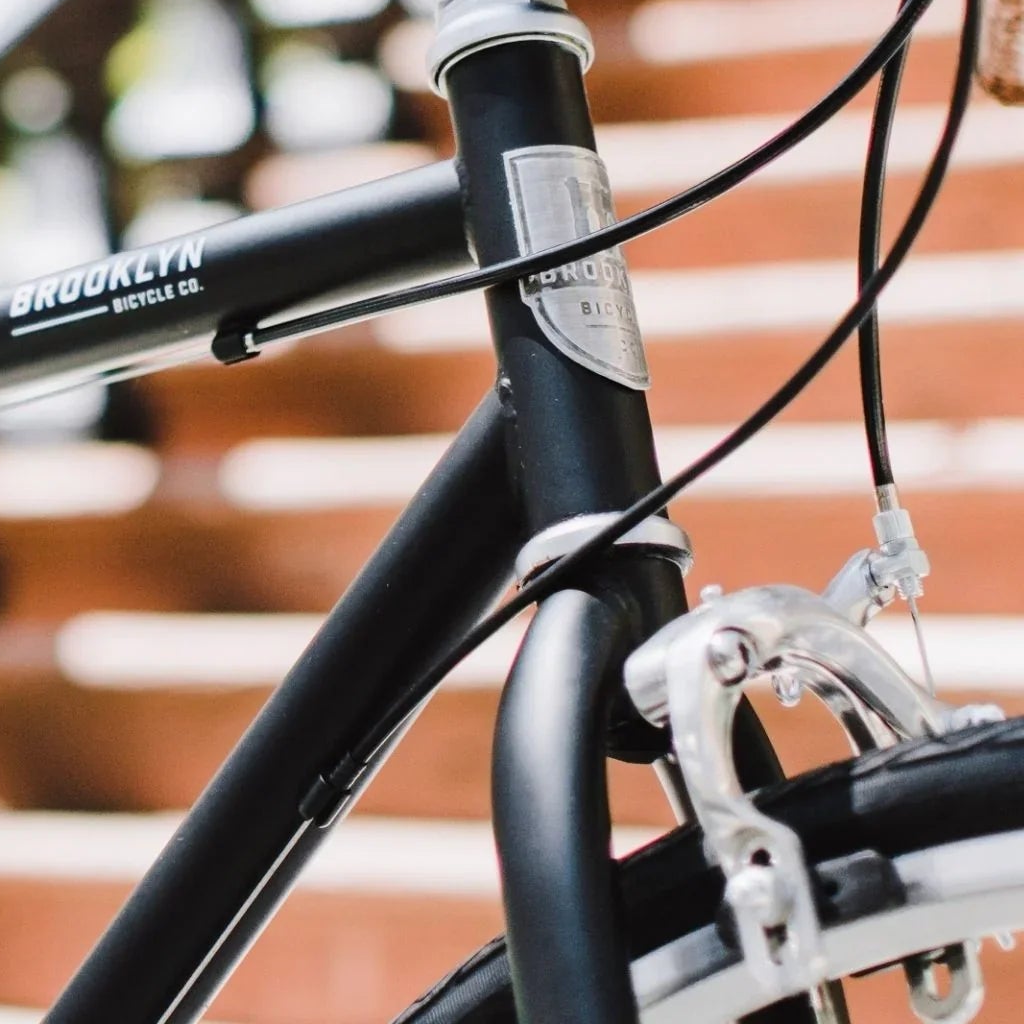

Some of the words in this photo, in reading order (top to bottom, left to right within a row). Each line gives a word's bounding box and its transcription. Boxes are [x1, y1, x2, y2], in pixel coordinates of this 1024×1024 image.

[9, 237, 206, 318] BROOKLYN
[112, 283, 175, 314] BICYCLE
[178, 277, 205, 296] CO.
